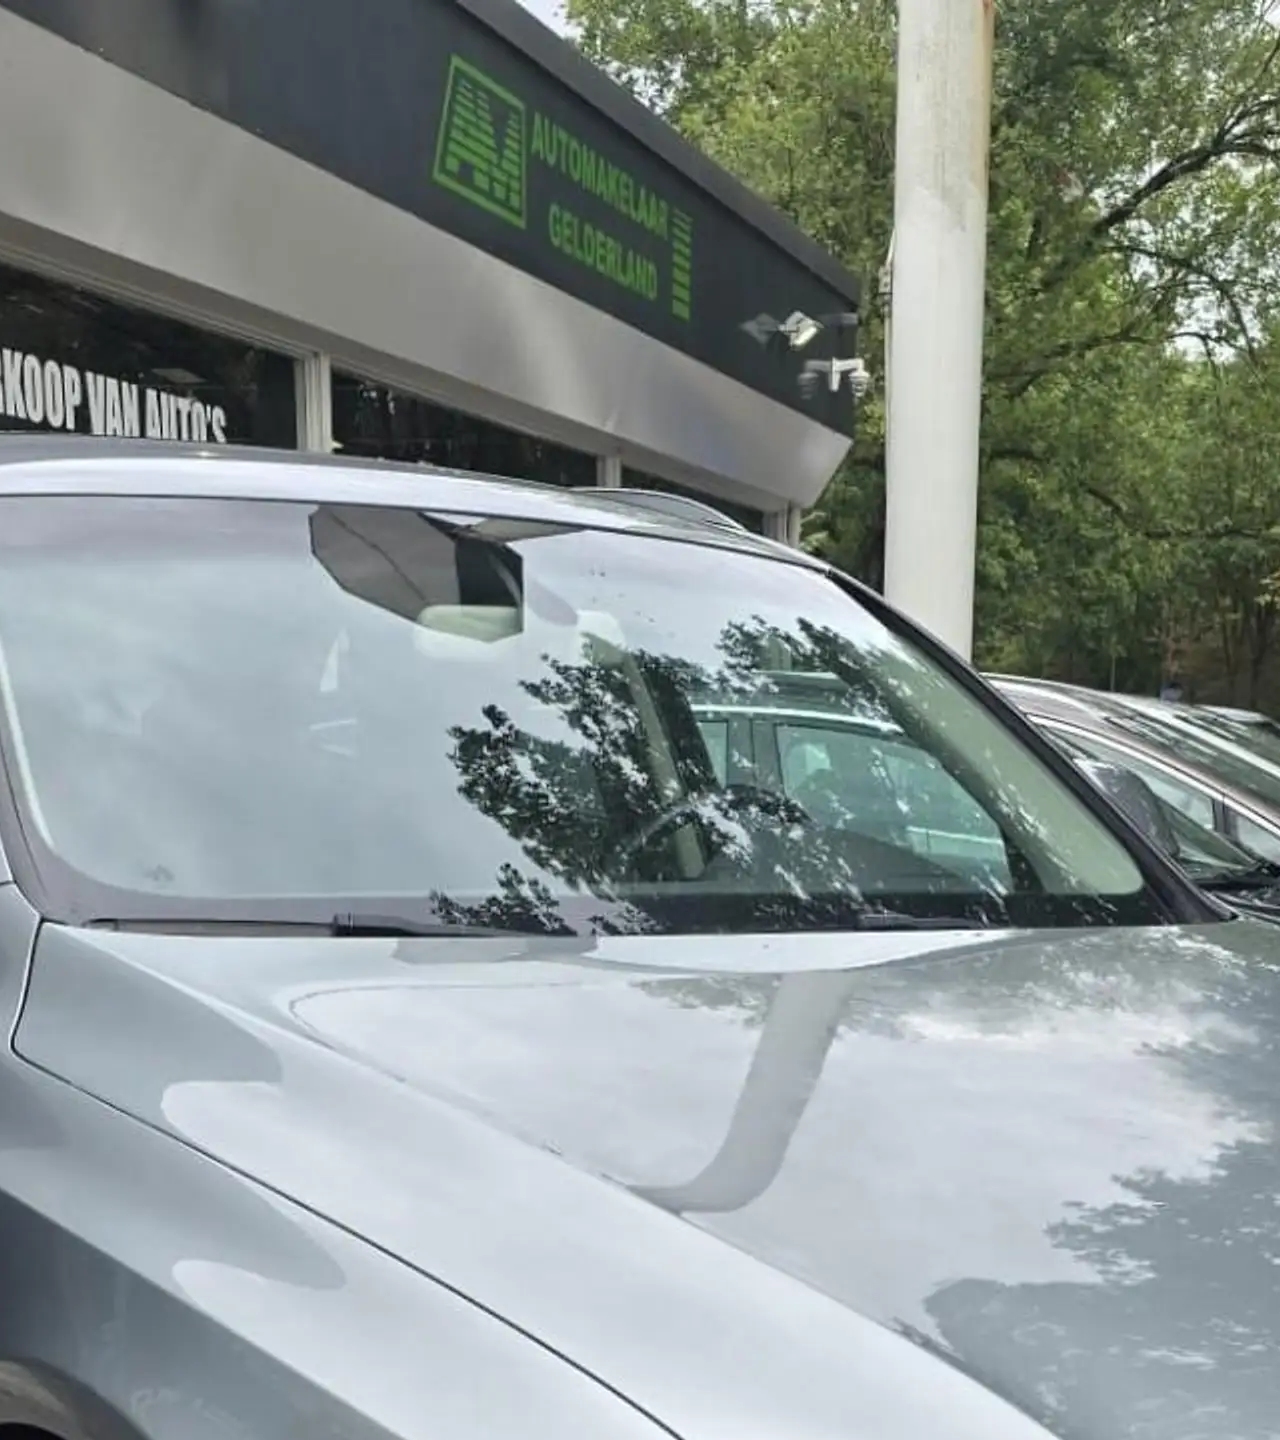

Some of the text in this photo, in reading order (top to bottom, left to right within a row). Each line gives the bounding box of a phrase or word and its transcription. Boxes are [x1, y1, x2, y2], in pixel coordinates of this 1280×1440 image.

[531, 112, 668, 240] AUTOMAKELAAR
[549, 203, 657, 300] GELDERLAND
[84, 369, 140, 437] VAN
[145, 387, 227, 444] AUTO'S
